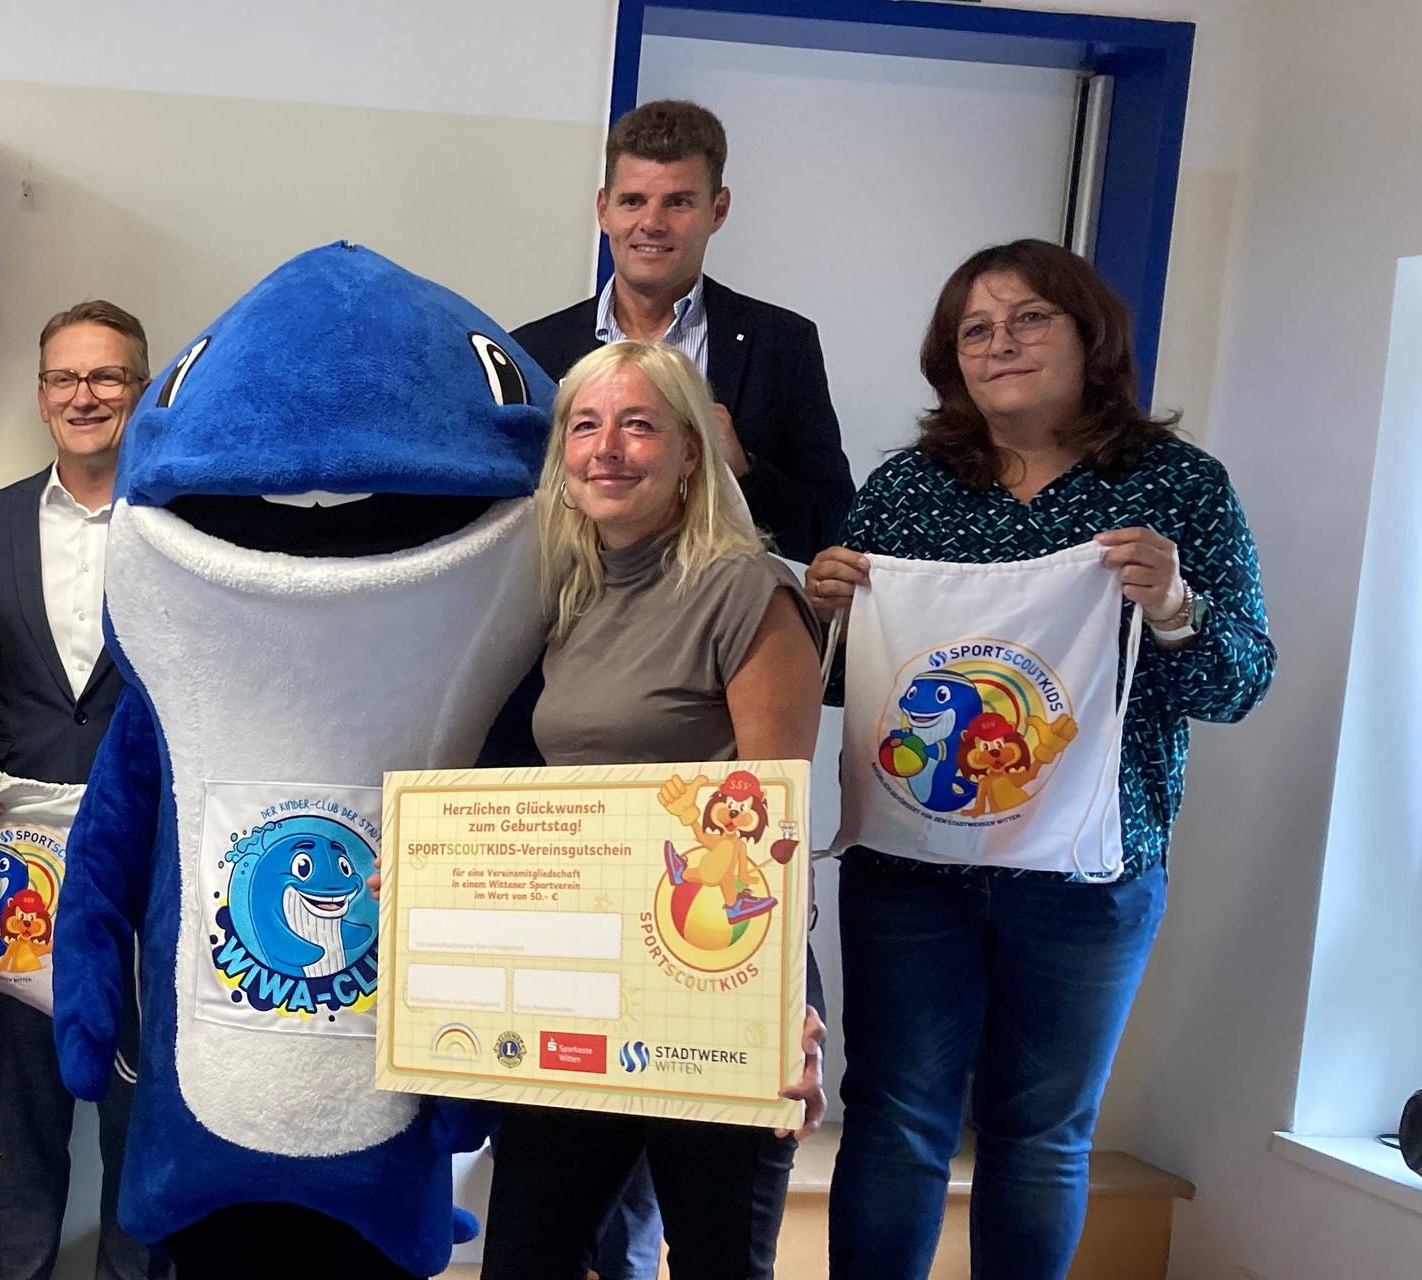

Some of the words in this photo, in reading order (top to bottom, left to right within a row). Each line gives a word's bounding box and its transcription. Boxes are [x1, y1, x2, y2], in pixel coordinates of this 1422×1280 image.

[949, 644, 1064, 712] SPORTSCOUTKIDS
[443, 803, 511, 816] Herzlichen
[516, 800, 606, 815] Glückwunsch
[260, 806, 278, 820] DER
[279, 799, 339, 813] KINDER-CLUB
[341, 807, 358, 823] DER
[358, 818, 382, 846] STADT
[468, 822, 496, 833] zum
[500, 818, 583, 835] Geburtstag!
[16, 830, 67, 859] SPORTSC
[407, 843, 632, 858] SPORTSCOUTKIDS-Vereinsgutschein
[452, 868, 465, 877] für
[468, 869, 484, 877] eine
[487, 868, 581, 880] Vereinsmitgliedschaft
[452, 880, 460, 888] in
[462, 880, 486, 888] einem
[489, 880, 527, 889] Wittener
[529, 881, 581, 891] Sportverein
[474, 891, 485, 900] im
[488, 891, 509, 900] Wert
[639, 911, 760, 993] SPORTSCOUTKIDS
[655, 1046, 748, 1065] STADTWERKE
[655, 1060, 703, 1075] WITTEN
